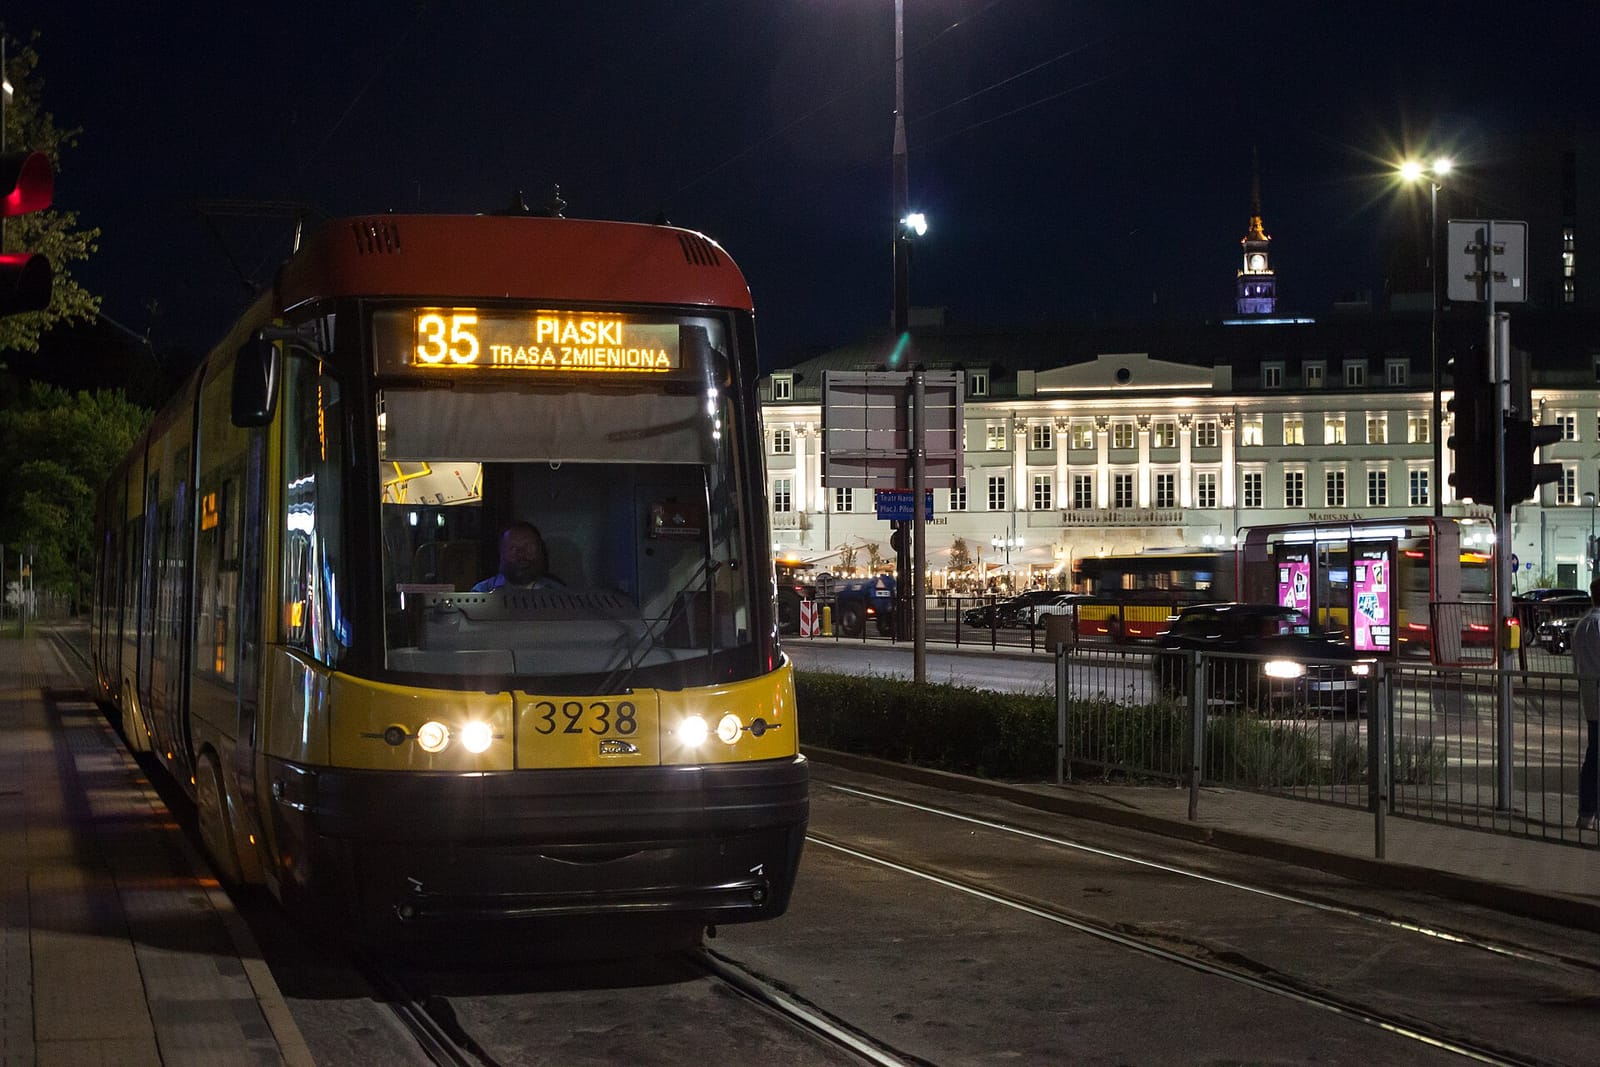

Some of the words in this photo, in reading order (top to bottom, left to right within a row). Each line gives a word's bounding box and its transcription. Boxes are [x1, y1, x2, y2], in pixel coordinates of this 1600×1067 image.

[417, 314, 479, 364] 35
[536, 319, 623, 345] PIASKI
[490, 345, 556, 365] TRASA
[560, 346, 670, 368] ZMIENIONA
[535, 701, 637, 735] 3238
